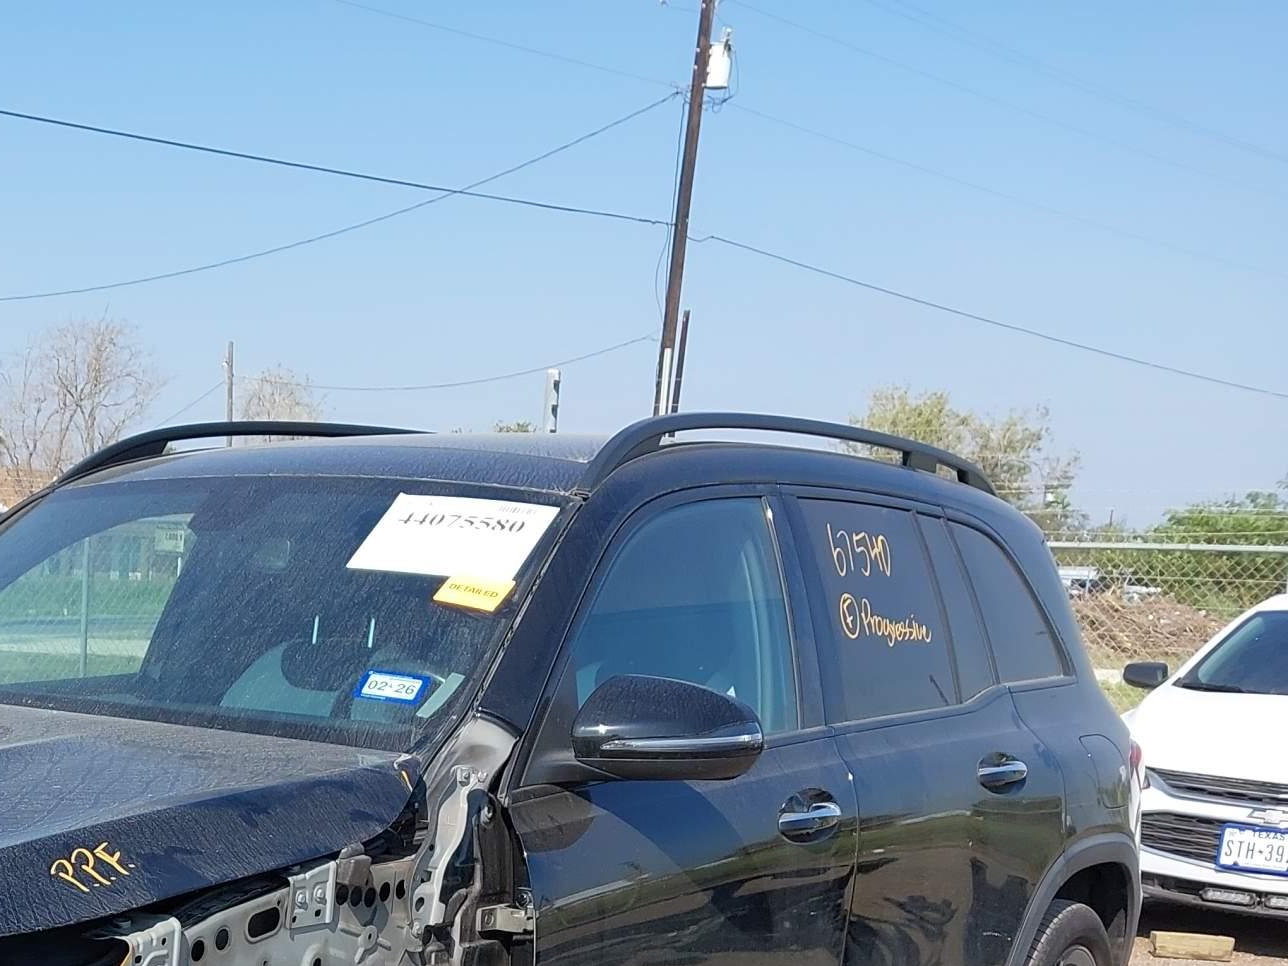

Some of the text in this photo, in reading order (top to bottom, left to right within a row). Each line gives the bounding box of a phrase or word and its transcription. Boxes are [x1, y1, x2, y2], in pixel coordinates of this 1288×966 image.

[398, 511, 526, 533] 44075580
[449, 583, 499, 598] DETAILED
[1224, 839, 1288, 863] STH-39
